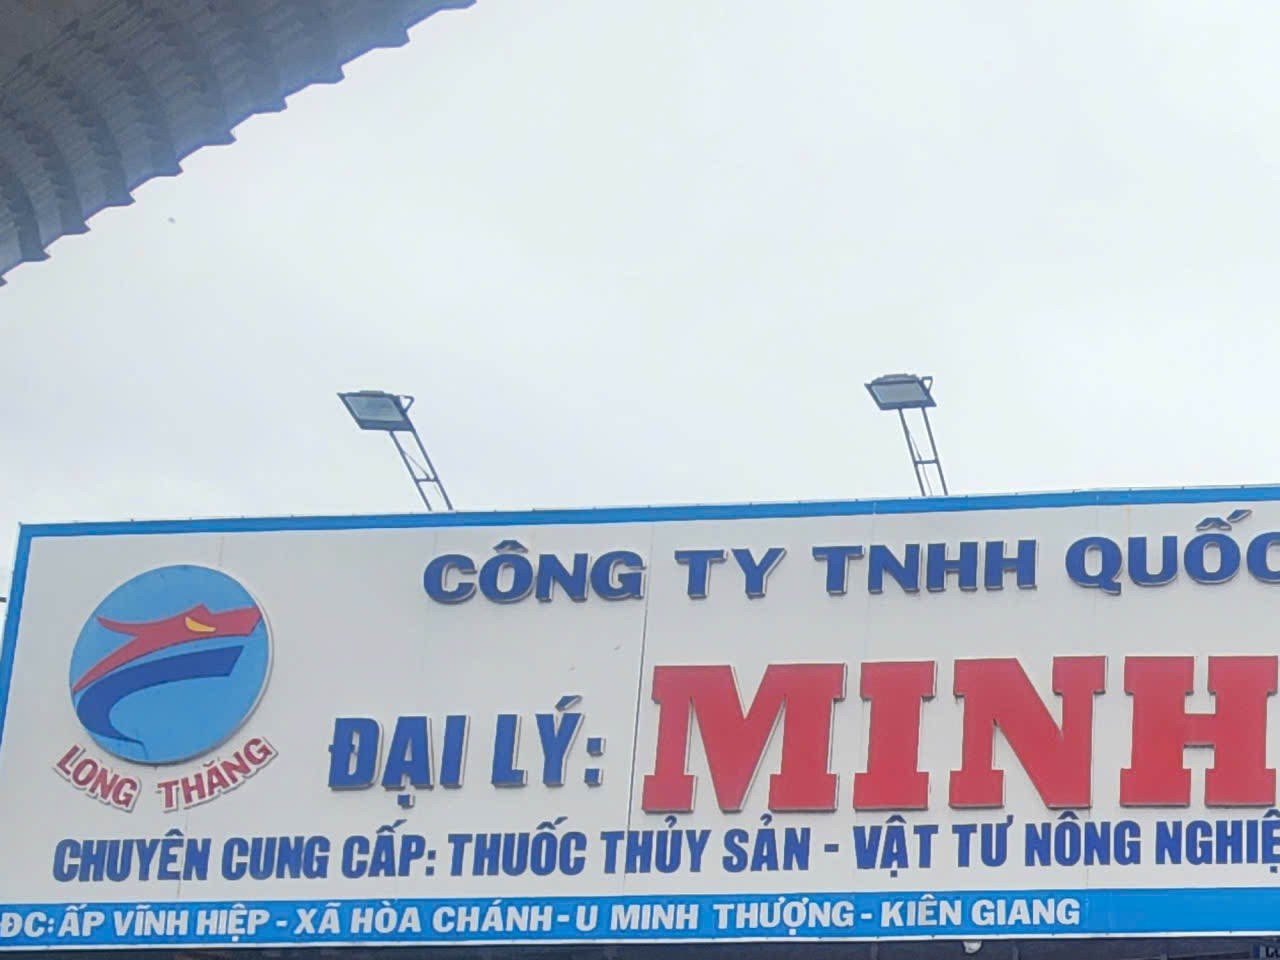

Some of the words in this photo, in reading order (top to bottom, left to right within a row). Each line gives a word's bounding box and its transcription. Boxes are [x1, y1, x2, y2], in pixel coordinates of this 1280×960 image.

[423, 540, 645, 604] CÔNG
[675, 547, 786, 600] TY
[812, 538, 1037, 596] TNHH
[328, 714, 470, 808] ĐẠI
[491, 695, 605, 786] LÝ:
[641, 655, 1278, 814] MINH
[56, 744, 137, 809] LONG
[157, 737, 273, 809] THĂNG
[52, 828, 211, 882] CHUYÊN
[221, 836, 330, 880] CUNG
[448, 816, 587, 876] THUỐC
[600, 815, 711, 874] THỦY
[722, 813, 811, 872] SẢN
[852, 814, 939, 878] VẬT
[952, 814, 1014, 868] TƯ
[1024, 810, 1142, 867] NÔNG
[112, 905, 190, 937] VĨNH
[195, 903, 271, 942] HIỆP
[293, 902, 342, 934] XÃ
[350, 900, 422, 934] HÒA
[432, 899, 554, 932] CHÁNH
[609, 903, 700, 931] MINH
[712, 897, 855, 936] THƯỢNG
[880, 894, 962, 929] KIÊN
[970, 898, 1081, 926] GIANG
